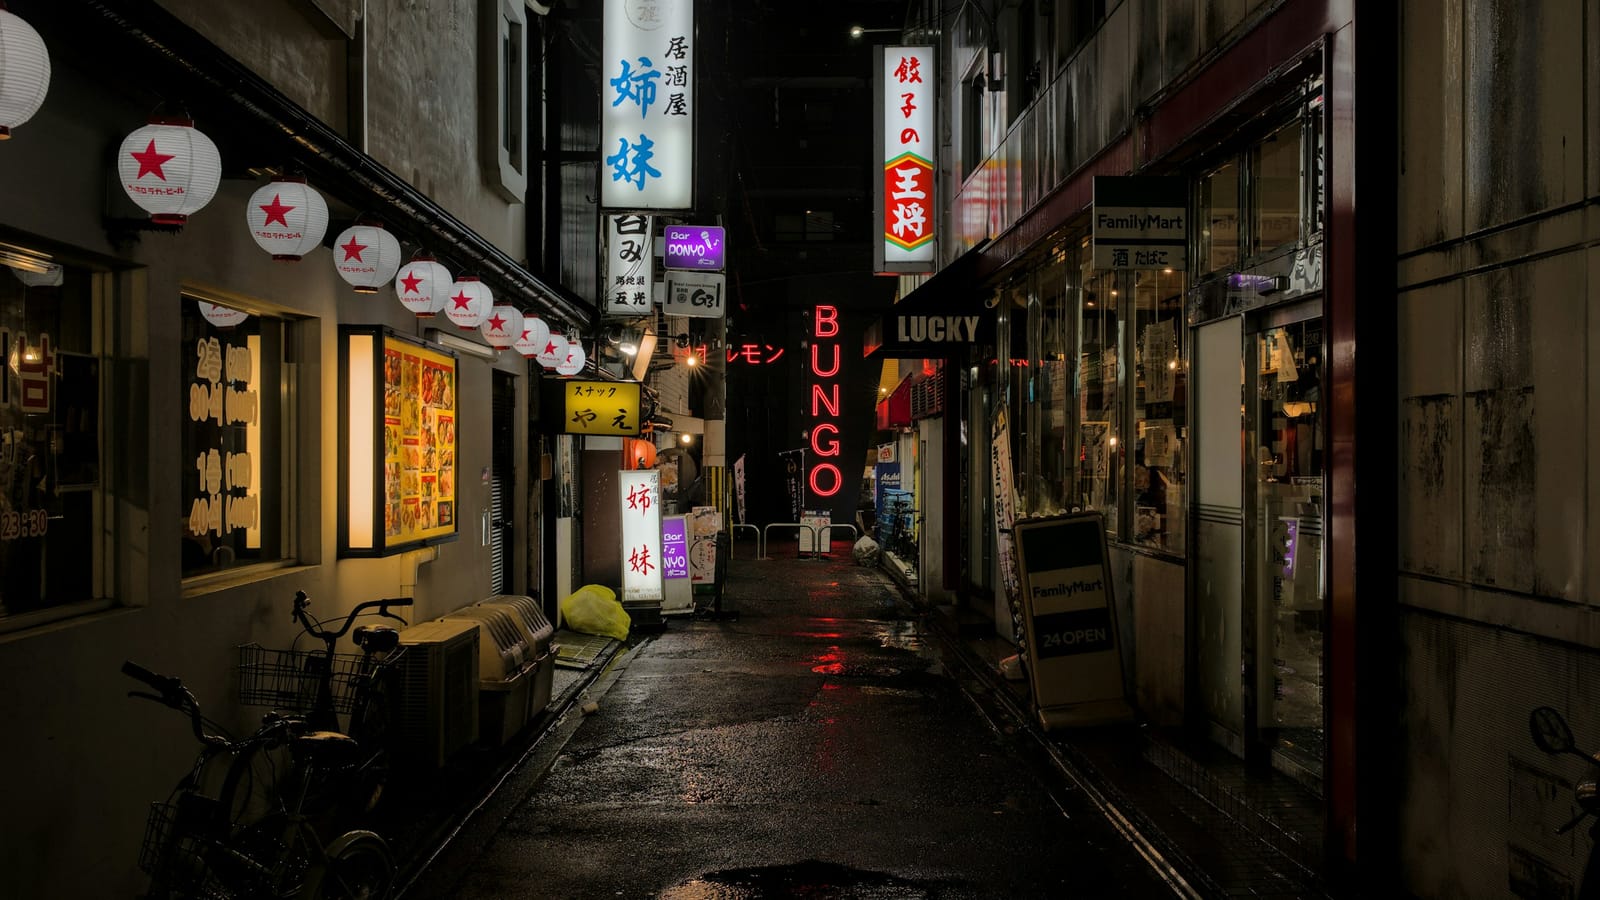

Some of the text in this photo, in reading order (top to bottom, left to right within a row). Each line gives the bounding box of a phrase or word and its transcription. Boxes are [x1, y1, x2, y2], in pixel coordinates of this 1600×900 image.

[664, 37, 689, 117] 居酒屋
[607, 57, 662, 191] 姉妹
[1098, 214, 1183, 231] FamilyMart
[670, 231, 690, 240] Bar
[668, 244, 705, 257] PONYO
[1113, 248, 1168, 266] 酒 たばこ
[614, 291, 646, 306] 五光
[897, 315, 982, 343] LUCKY
[574, 386, 617, 398] スナック
[809, 304, 843, 498] BUNGO
[626, 483, 655, 576] 姉妹
[663, 533, 682, 541] Bar
[1032, 580, 1103, 598] FamilyMart
